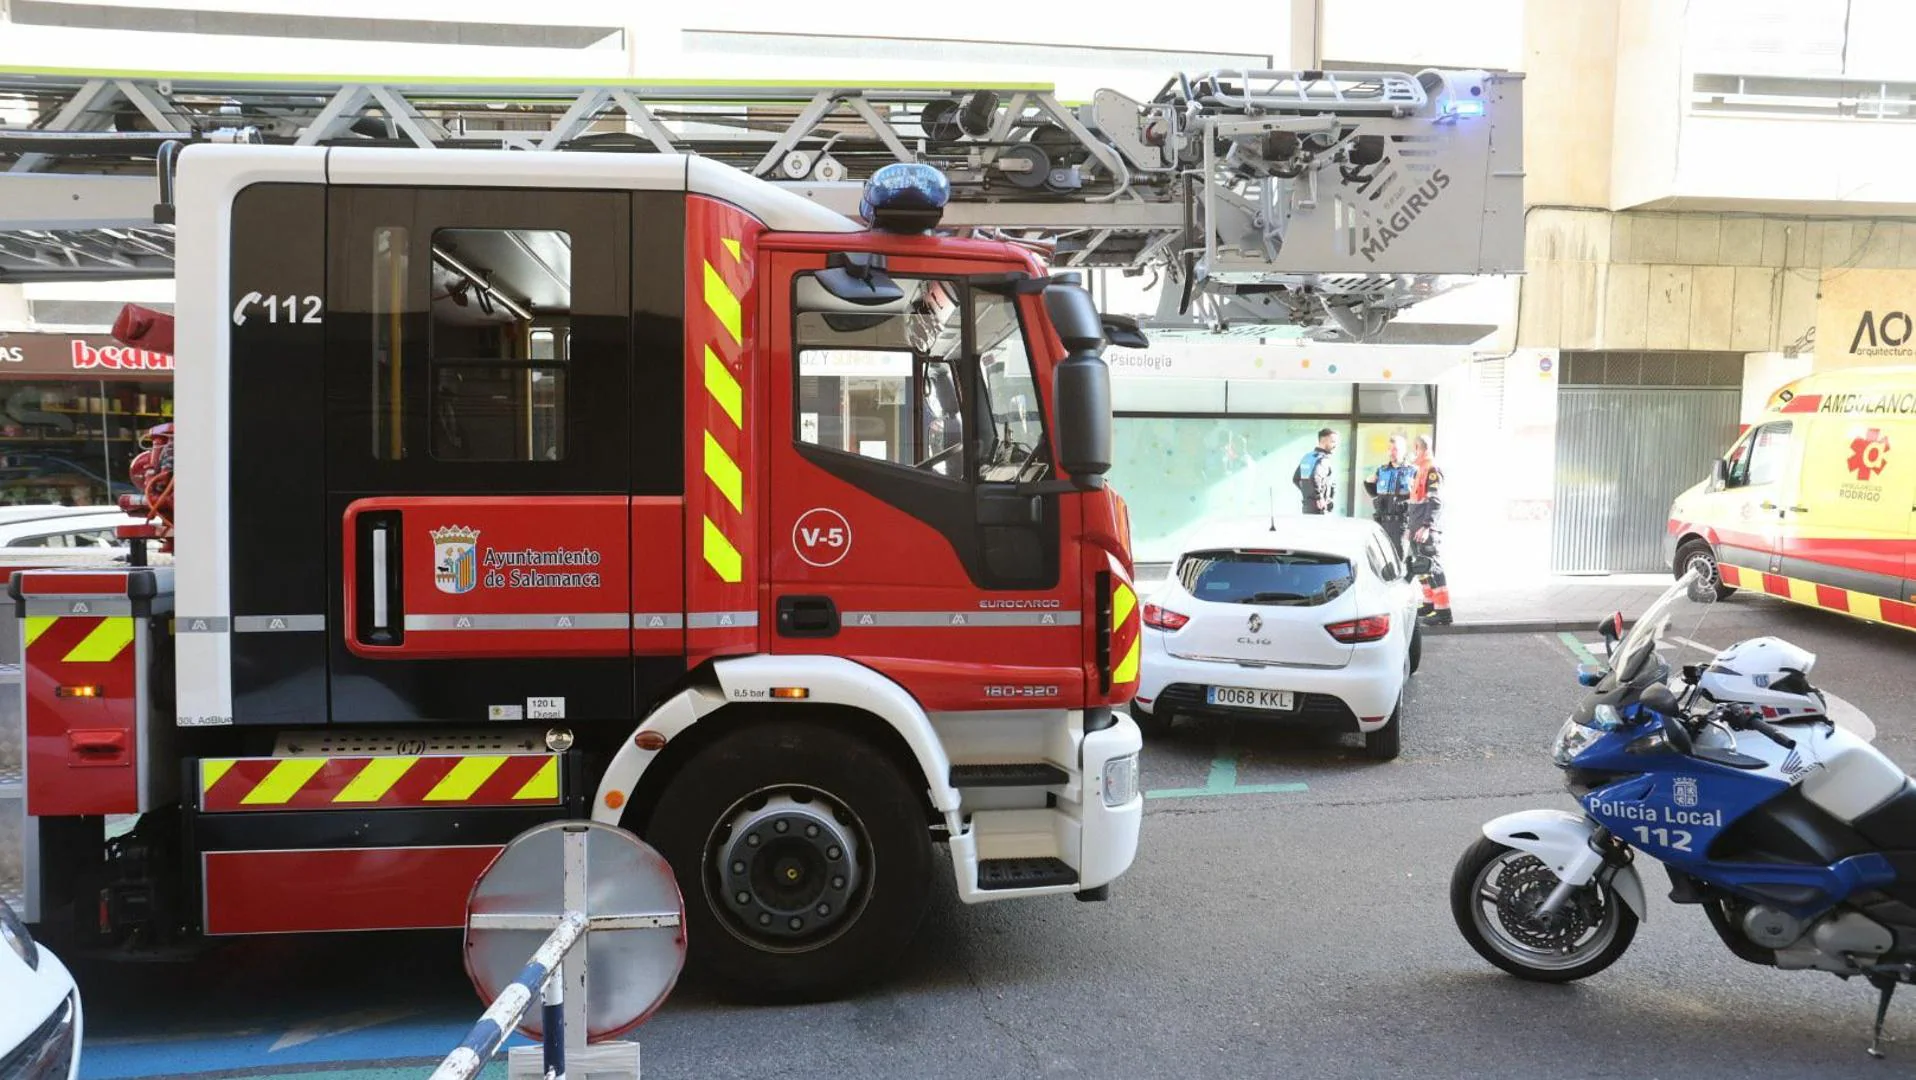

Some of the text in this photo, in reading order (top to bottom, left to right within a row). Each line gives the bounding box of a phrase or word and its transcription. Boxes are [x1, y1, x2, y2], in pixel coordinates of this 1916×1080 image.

[1360, 168, 1450, 263] MAGIRUS
[262, 294, 323, 324] 112
[71, 339, 174, 369] beau
[1856, 347, 1913, 357] arquitectura
[1839, 489, 1881, 503] RODRIGO
[801, 527, 844, 548] V-5
[483, 547, 600, 567] Ayuntamiento
[484, 569, 600, 588] de Salamanca
[979, 599, 1061, 608] EUROCARGO
[1237, 637, 1272, 645] CLIO
[750, 689, 765, 698] bar
[983, 685, 1059, 697] 180-320
[1217, 688, 1289, 708] 0068 KKL
[532, 699, 548, 708] 120
[1590, 797, 1722, 827] Policía Local
[1632, 825, 1692, 853] 112
